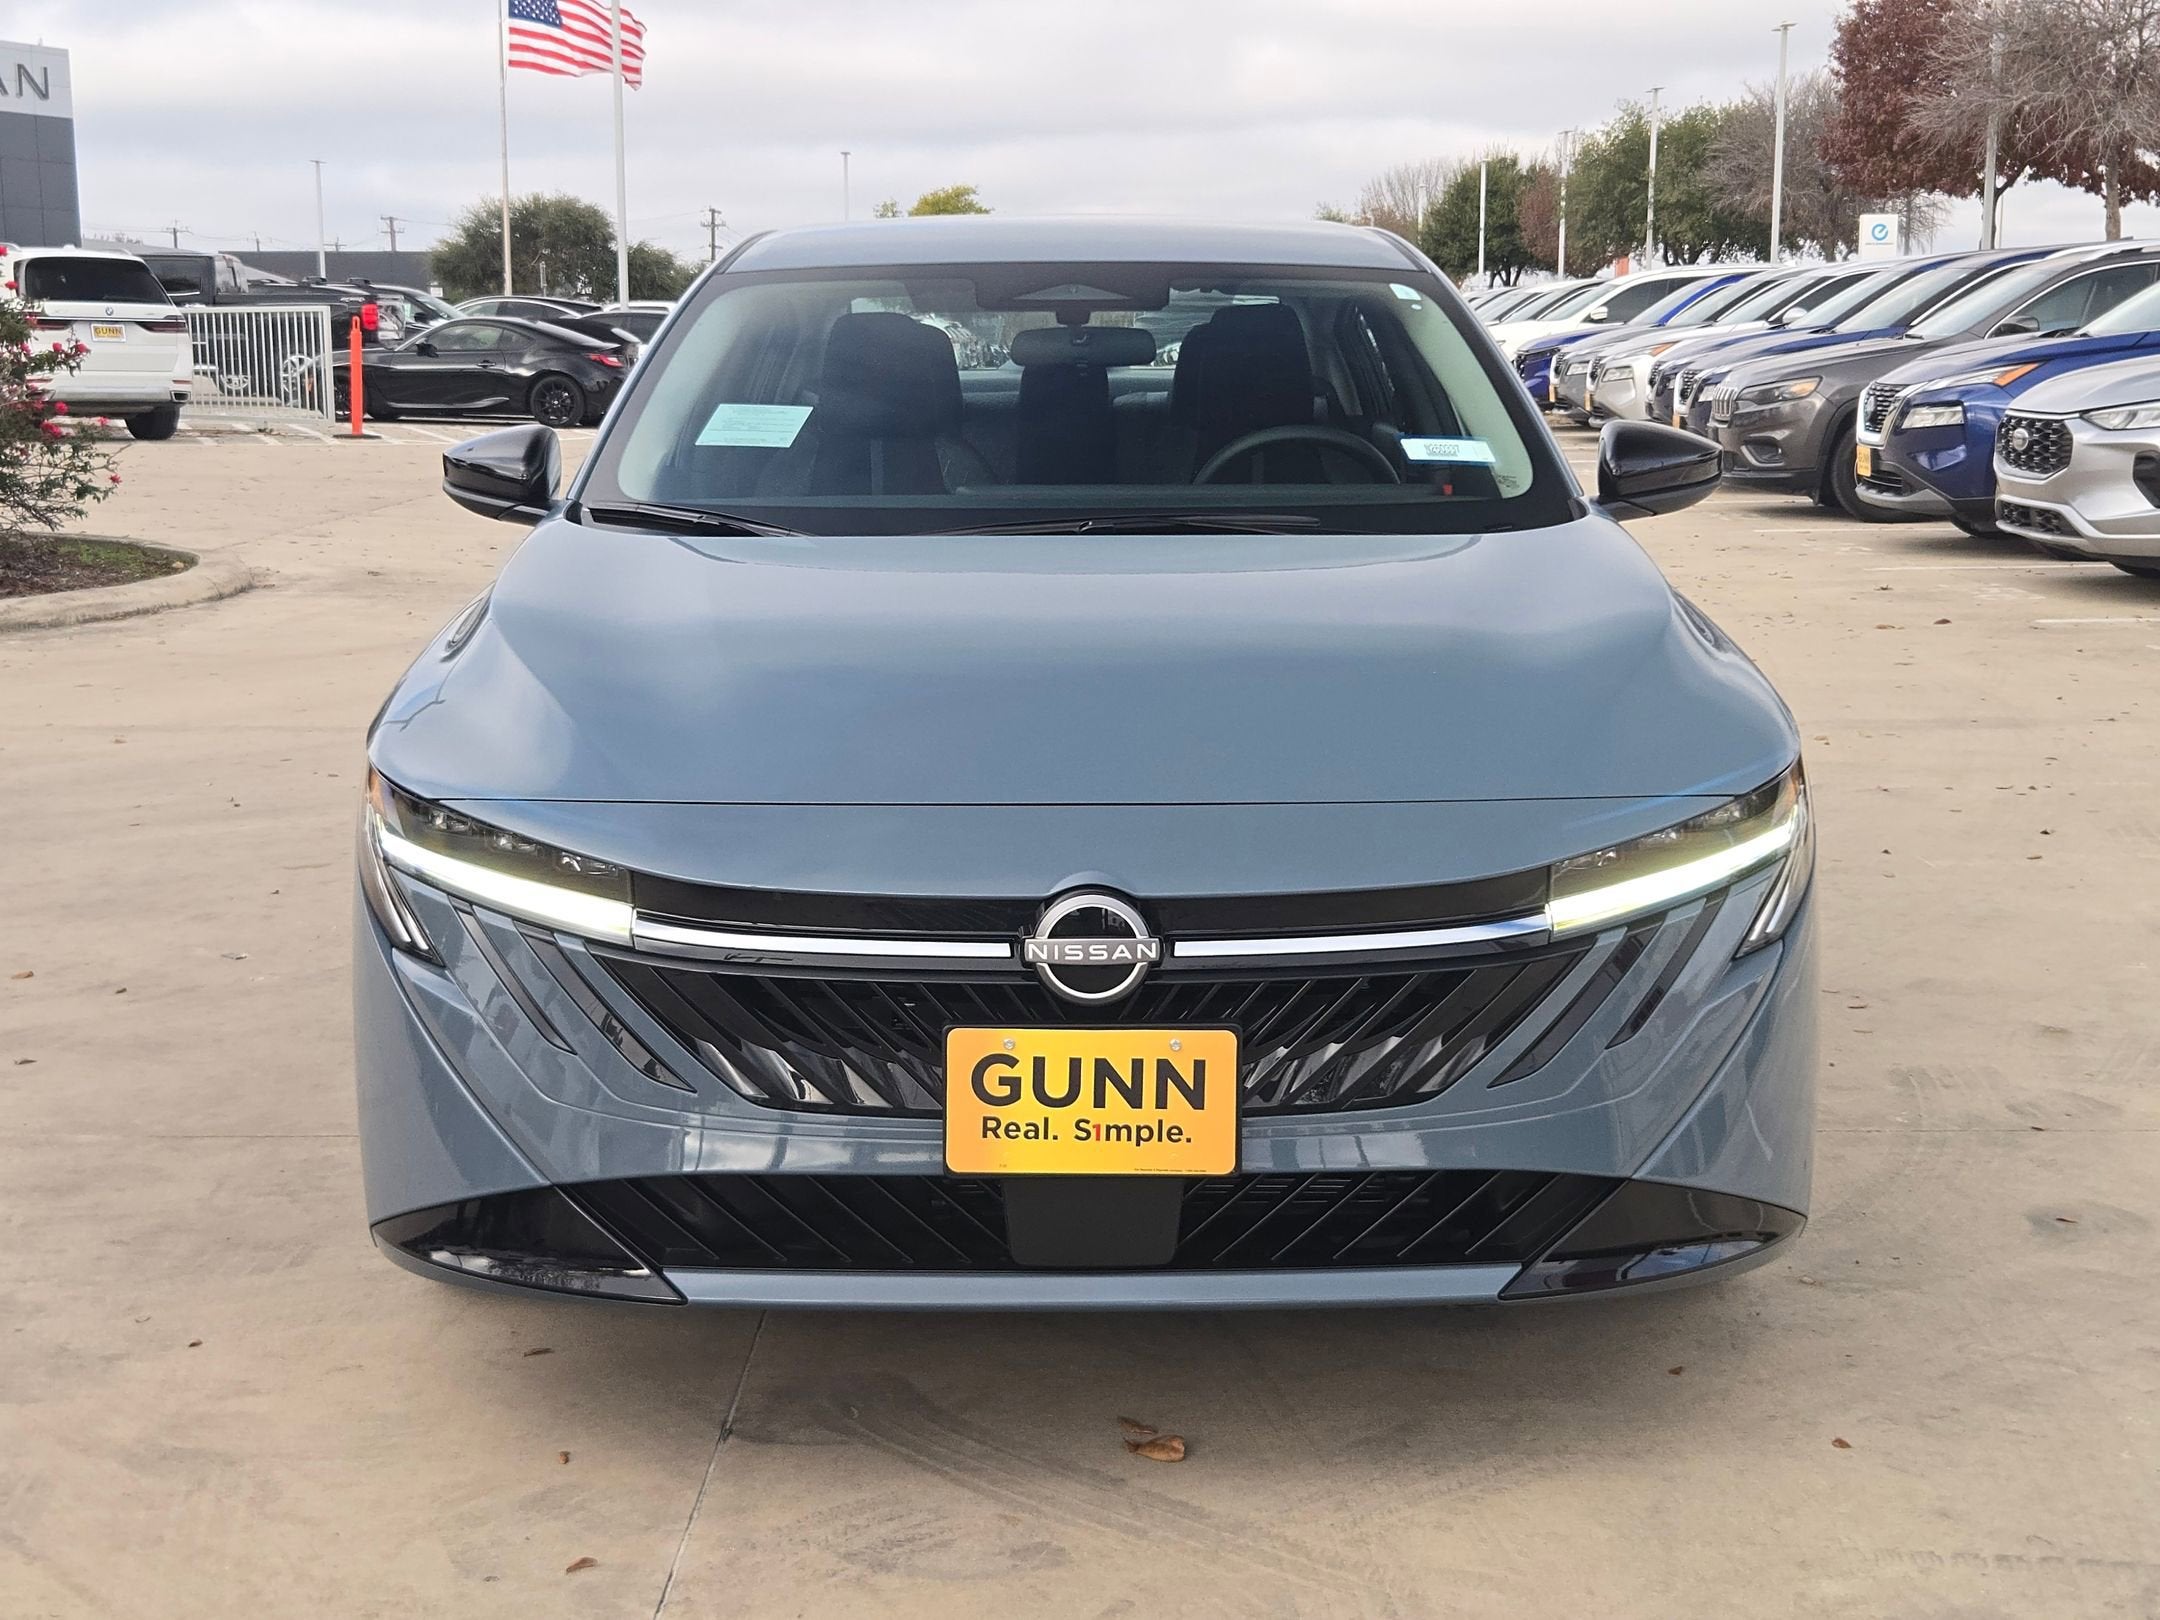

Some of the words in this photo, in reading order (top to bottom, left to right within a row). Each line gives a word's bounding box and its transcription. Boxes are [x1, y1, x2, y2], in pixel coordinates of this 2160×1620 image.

[0, 63, 49, 100] N
[1028, 941, 1158, 961] NISSAN
[970, 1053, 1206, 1111] GUNN
[981, 1115, 1059, 1141] Real.
[1073, 1117, 1192, 1147] S1mple.
